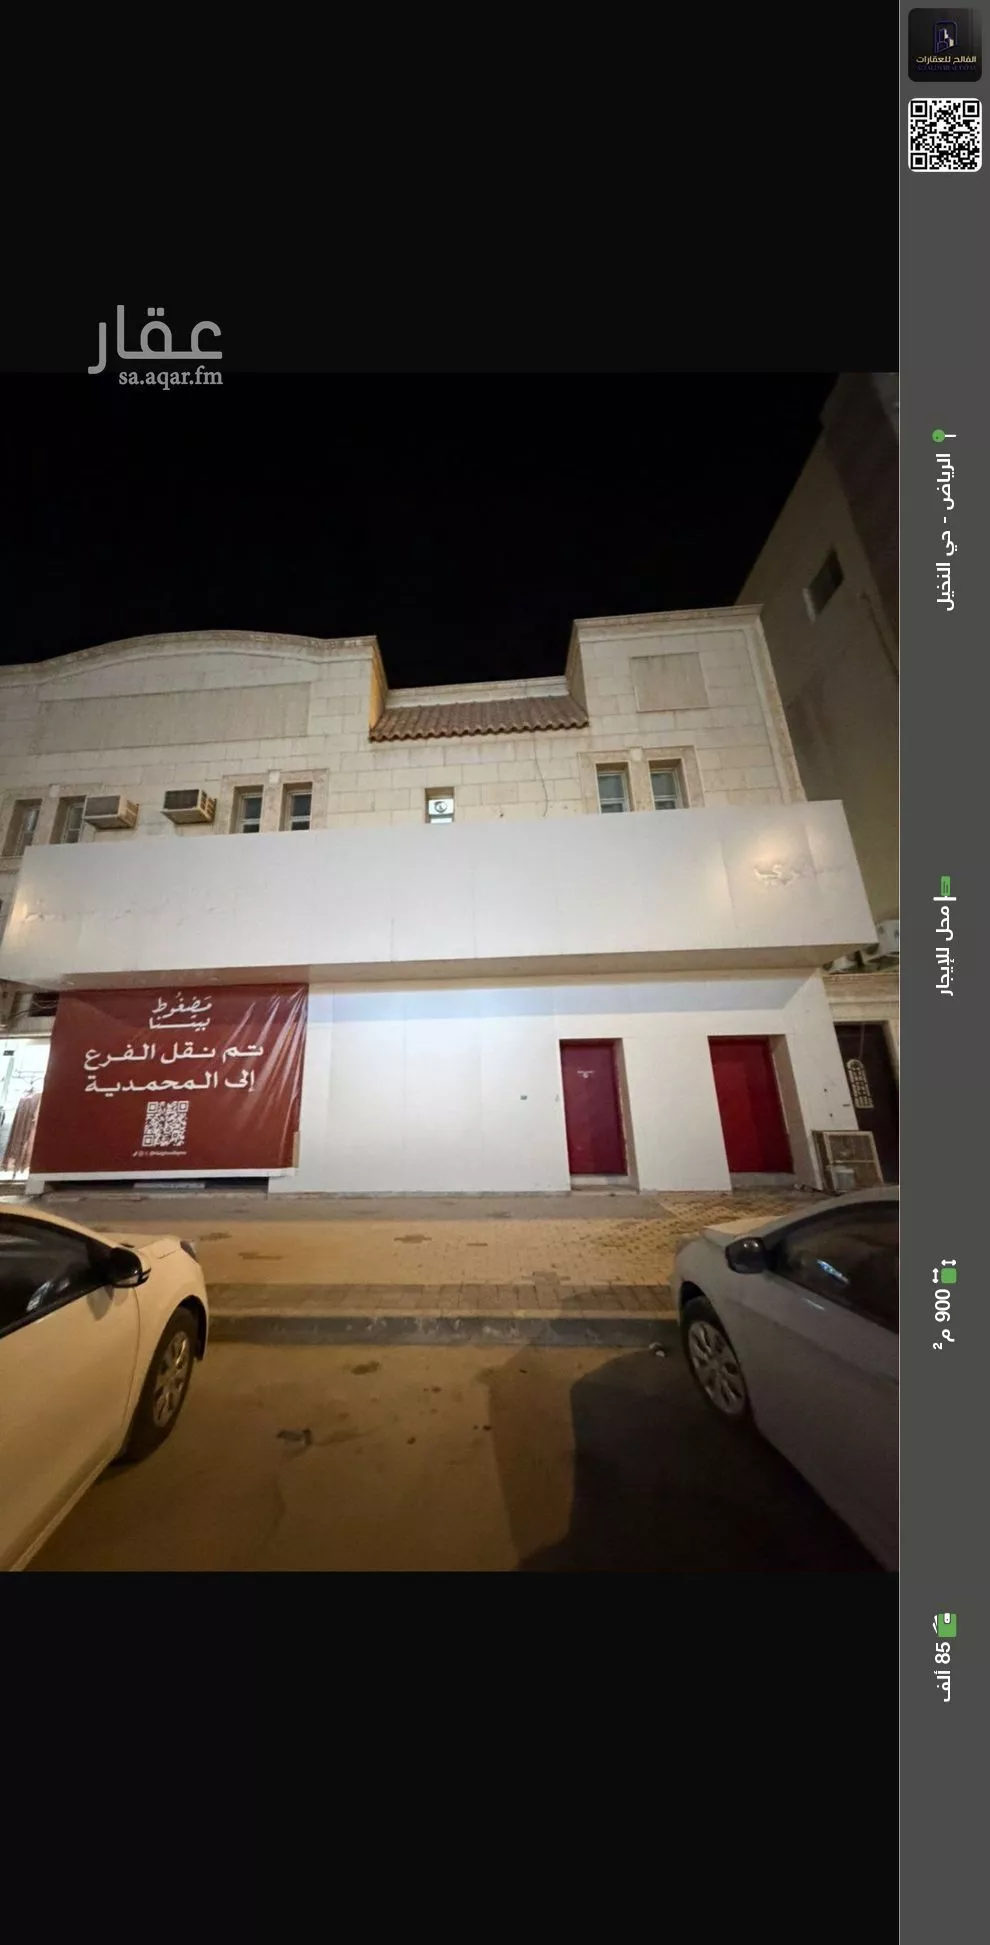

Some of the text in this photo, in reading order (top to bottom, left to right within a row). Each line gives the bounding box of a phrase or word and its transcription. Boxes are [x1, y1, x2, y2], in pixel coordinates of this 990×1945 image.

[83, 1041, 264, 1071] تم نقل الفرع
[84, 1069, 255, 1098] إلى المحمدية
